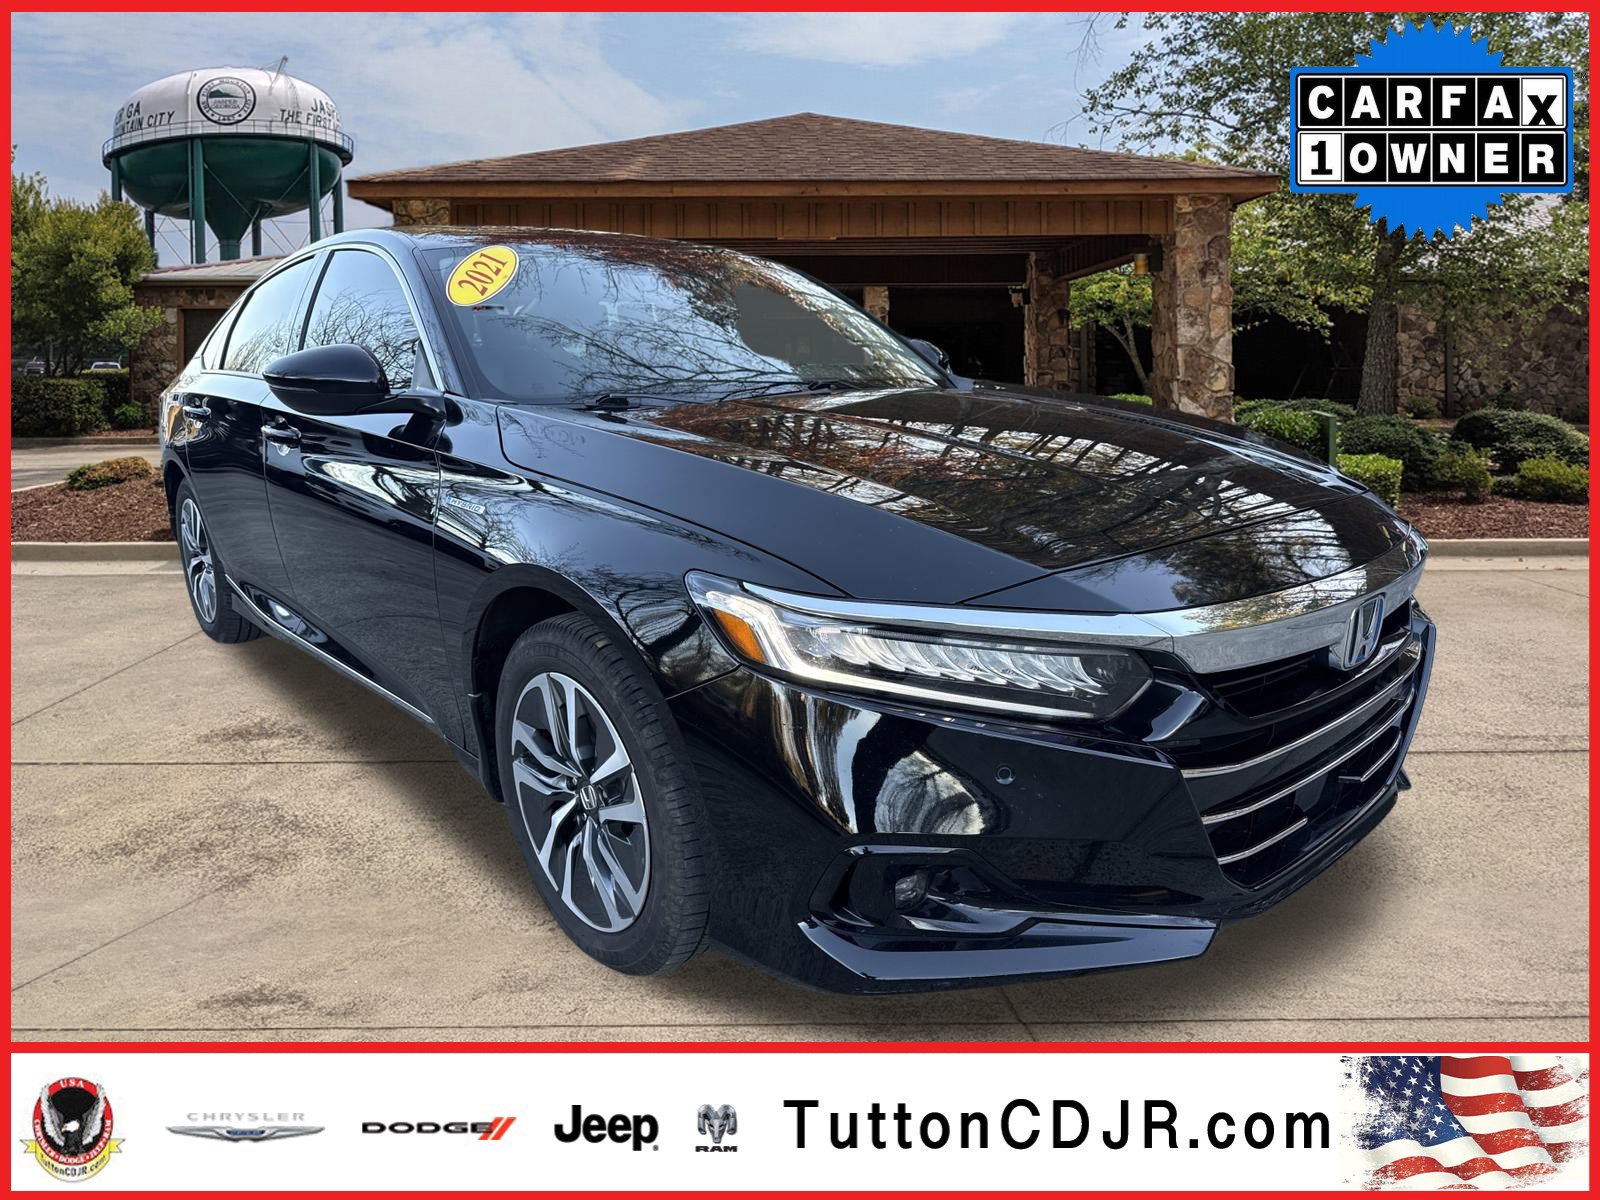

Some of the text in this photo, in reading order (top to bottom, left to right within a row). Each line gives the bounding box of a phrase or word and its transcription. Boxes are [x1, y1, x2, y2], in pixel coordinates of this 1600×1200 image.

[126, 101, 140, 119] GA
[147, 110, 176, 127] CITY
[280, 108, 302, 124] THE
[306, 112, 332, 130] FIRST
[457, 252, 508, 296] 2021
